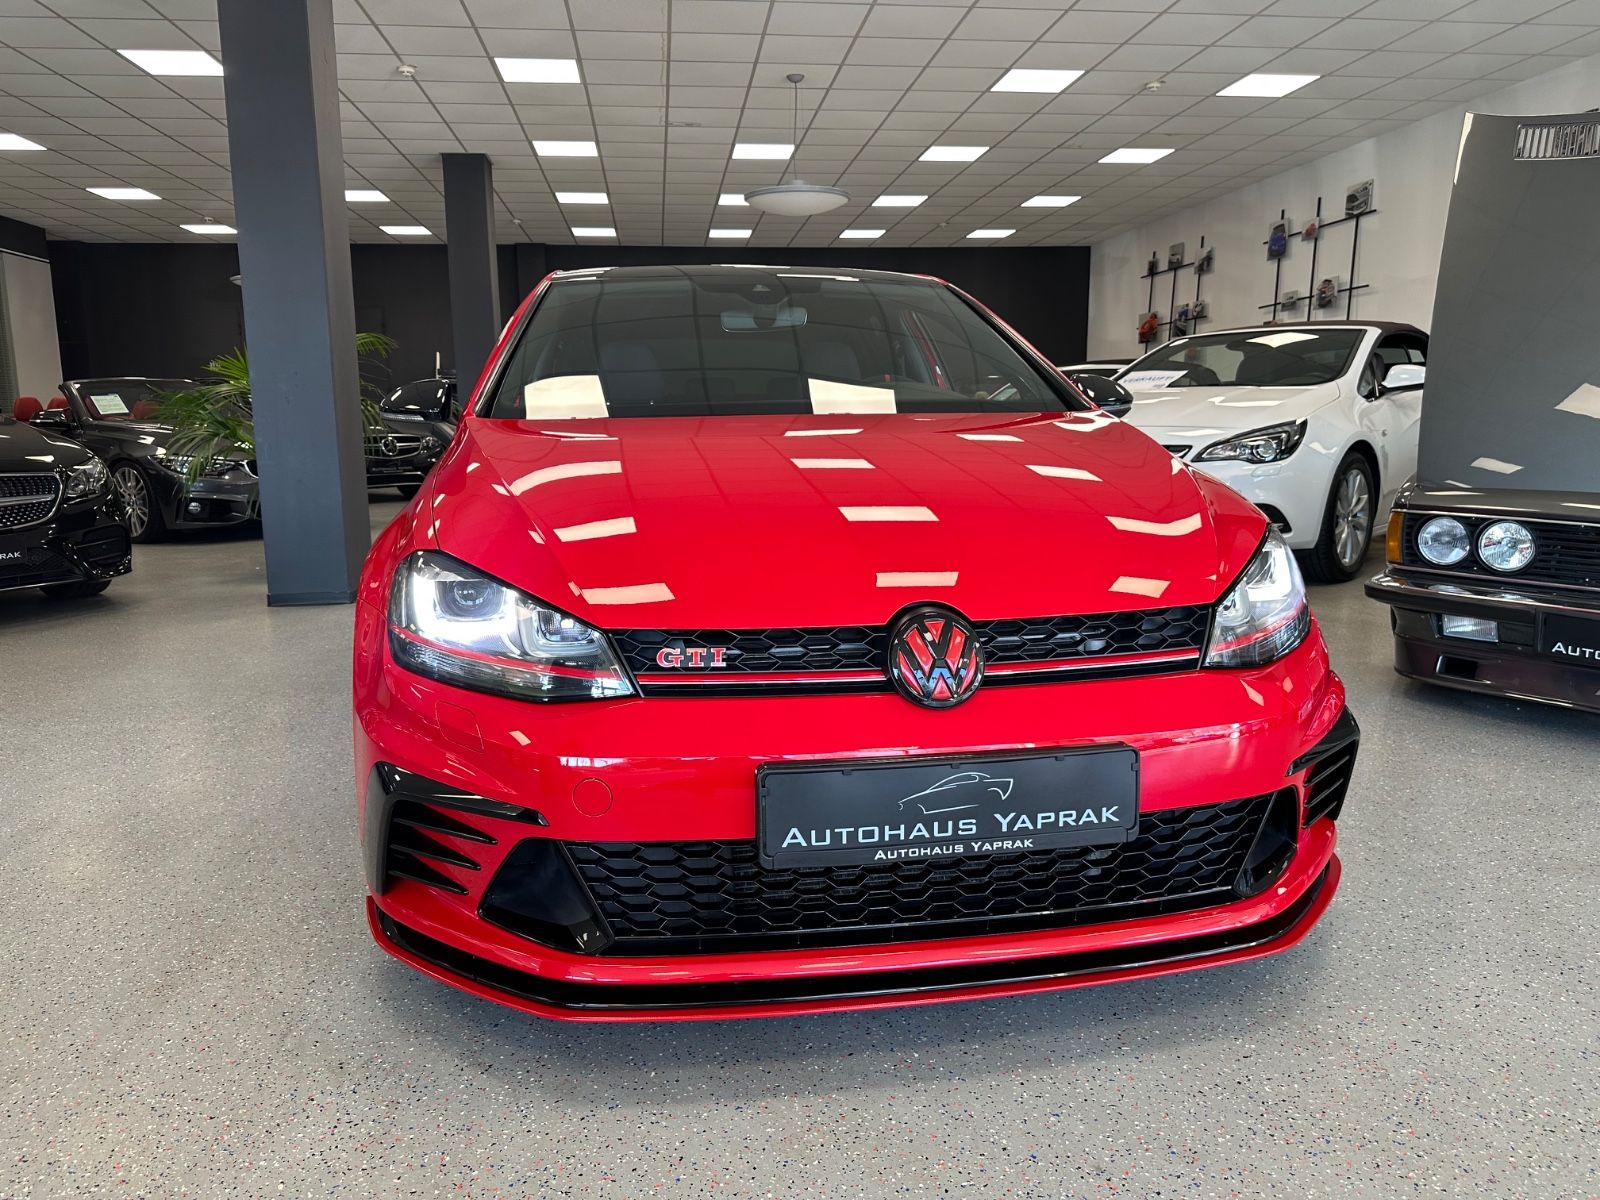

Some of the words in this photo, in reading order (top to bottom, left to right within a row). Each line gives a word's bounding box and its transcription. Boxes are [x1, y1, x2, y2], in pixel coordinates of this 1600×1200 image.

[656, 647, 727, 668] GTI
[781, 819, 977, 848] AUTOHAUS
[993, 806, 1120, 832] YAPRAK
[874, 844, 964, 860] AUTOHAUS
[971, 839, 1034, 852] YAPRAK
